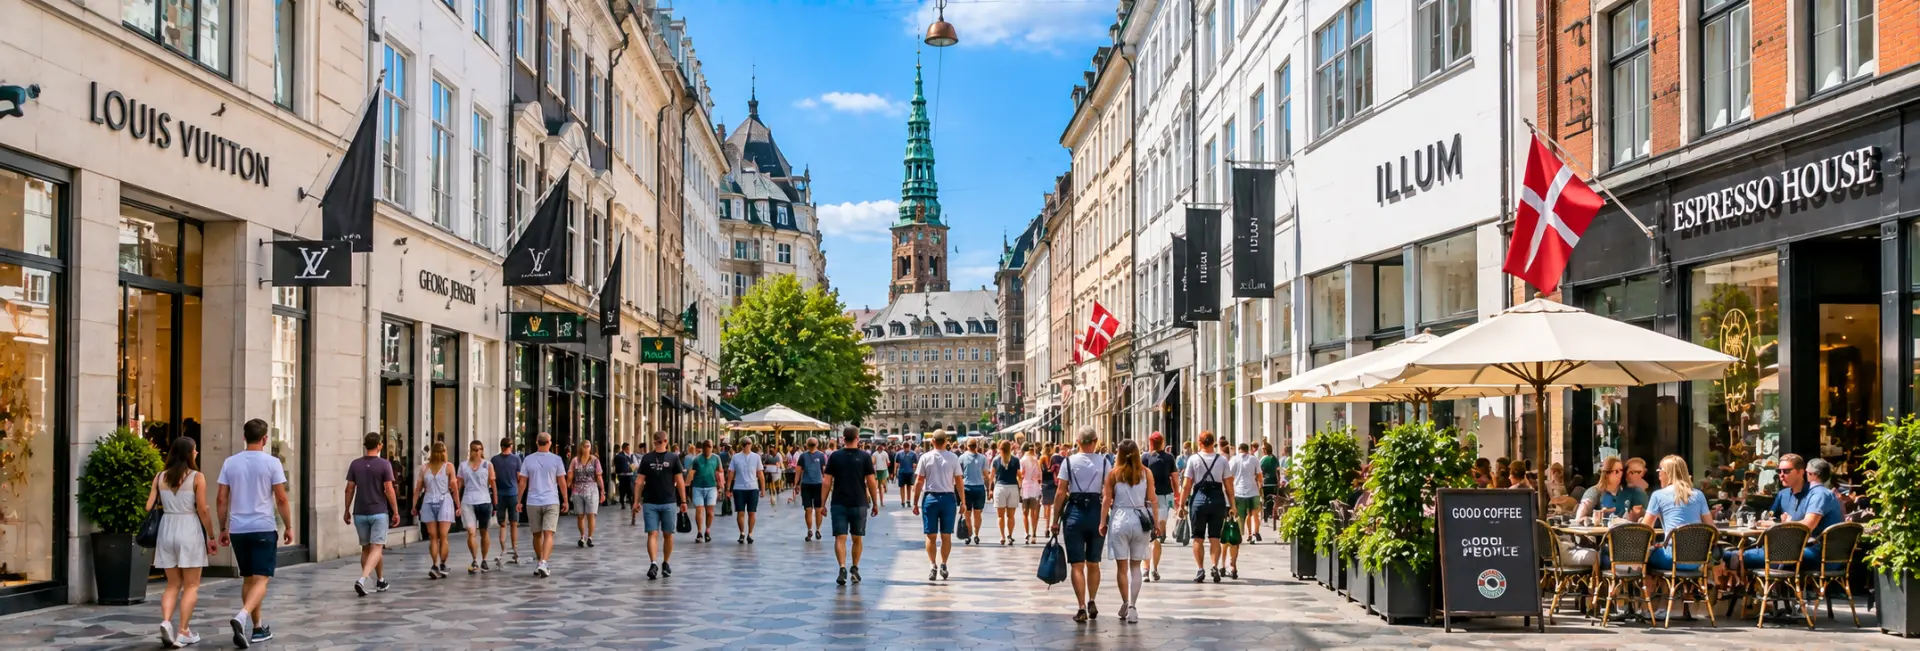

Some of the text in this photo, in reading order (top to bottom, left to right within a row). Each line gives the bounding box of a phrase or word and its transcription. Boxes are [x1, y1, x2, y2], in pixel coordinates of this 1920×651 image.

[90, 81, 270, 187] LOUIS VUITTON
[1376, 132, 1462, 206] ILLUM
[1672, 145, 1876, 231] ESPRESSO HOUSE
[419, 269, 476, 305] GEORG JENSEN
[1452, 507, 1523, 519] GOOD COFFEE
